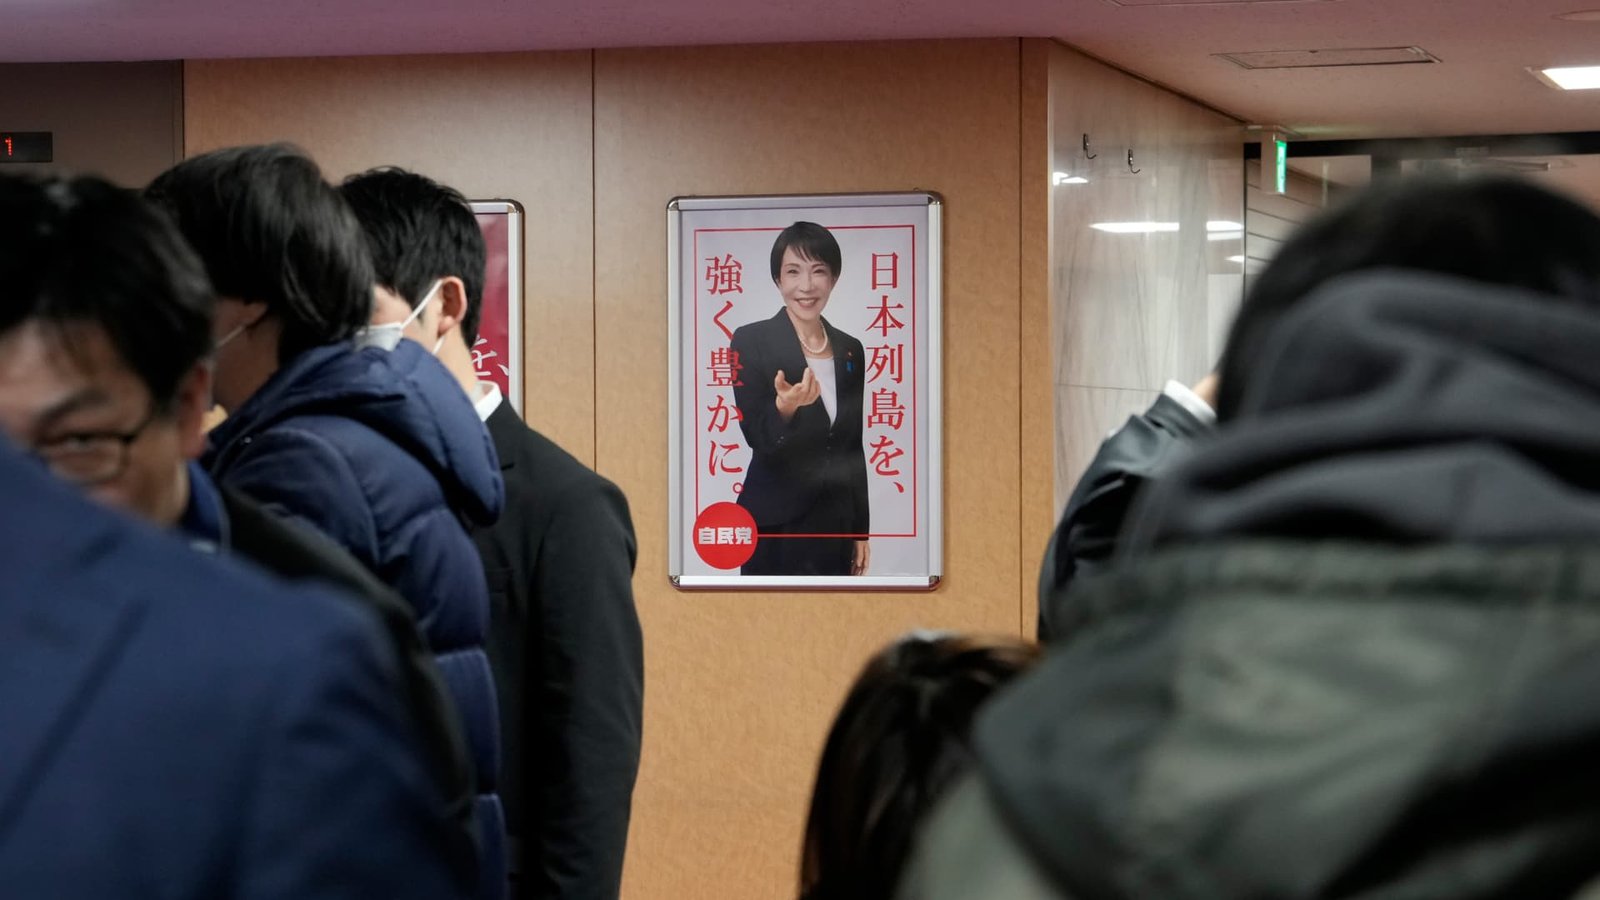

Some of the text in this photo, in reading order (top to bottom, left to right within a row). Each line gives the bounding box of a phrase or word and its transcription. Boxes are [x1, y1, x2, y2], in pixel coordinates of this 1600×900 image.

[4, 137, 13, 157] 1
[704, 252, 745, 495] 強く豊かに。
[865, 251, 906, 494] 日本列島を、
[698, 526, 753, 545] 自民党
